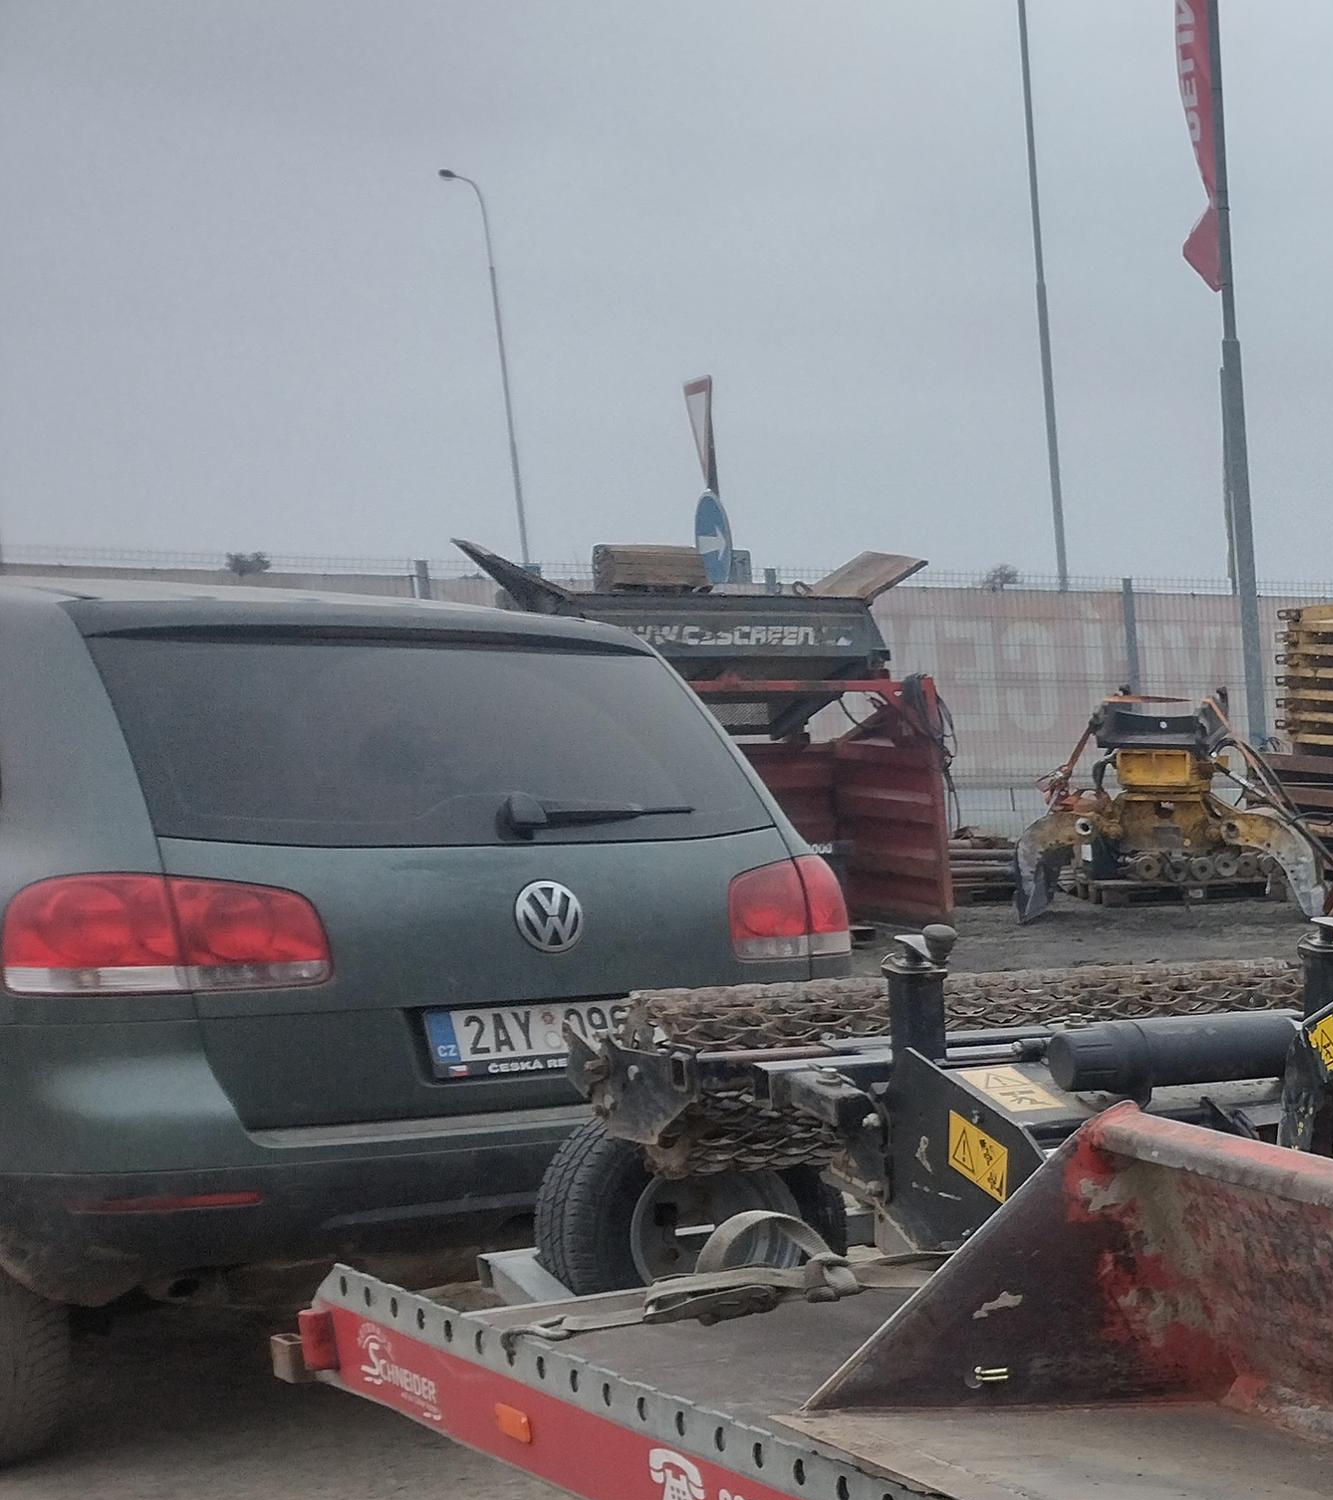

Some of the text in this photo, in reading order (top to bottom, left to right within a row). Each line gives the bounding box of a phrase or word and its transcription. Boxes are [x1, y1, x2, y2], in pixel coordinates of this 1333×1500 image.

[464, 1011, 533, 1054] 2AY
[437, 1044, 457, 1057] CZ
[488, 1058, 543, 1073] ČESKÁ
